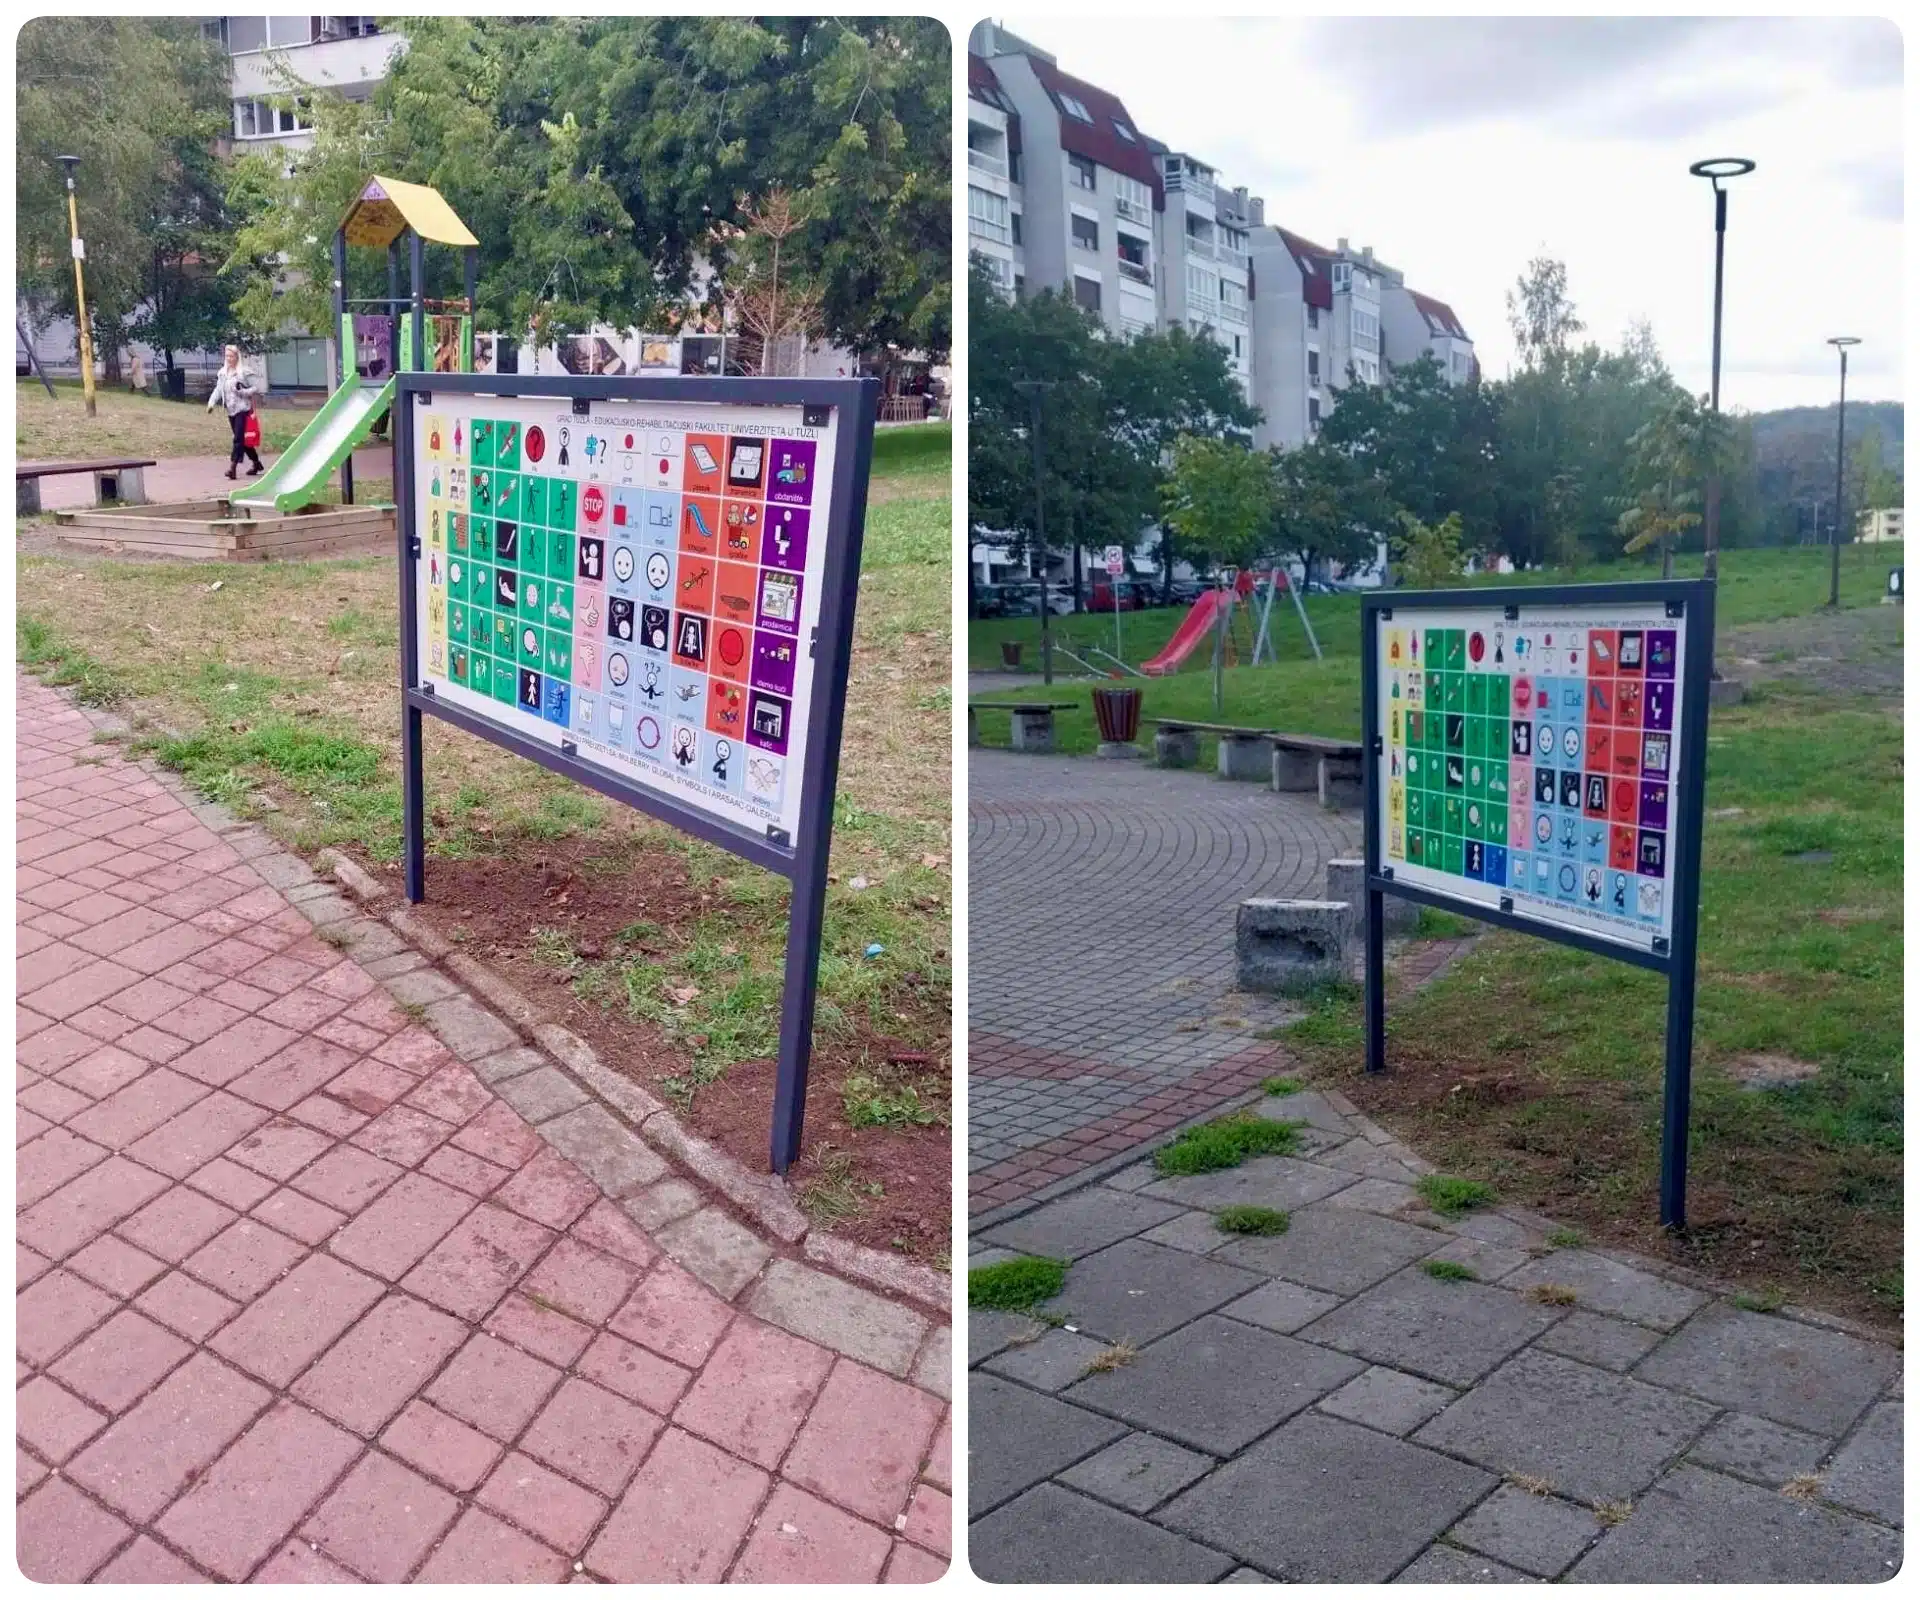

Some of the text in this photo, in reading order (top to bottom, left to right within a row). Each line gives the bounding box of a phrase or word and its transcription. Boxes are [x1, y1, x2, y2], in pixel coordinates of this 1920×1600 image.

[573, 415, 590, 424] TUZLA
[694, 422, 730, 432] FAKULTET
[732, 424, 786, 436] UNIVERZITETA
[788, 428, 793, 436] U
[796, 427, 819, 439] TUZLI
[584, 498, 602, 514] STOP
[652, 766, 675, 782] GLOBAL
[677, 776, 708, 796] SYMBOLS
